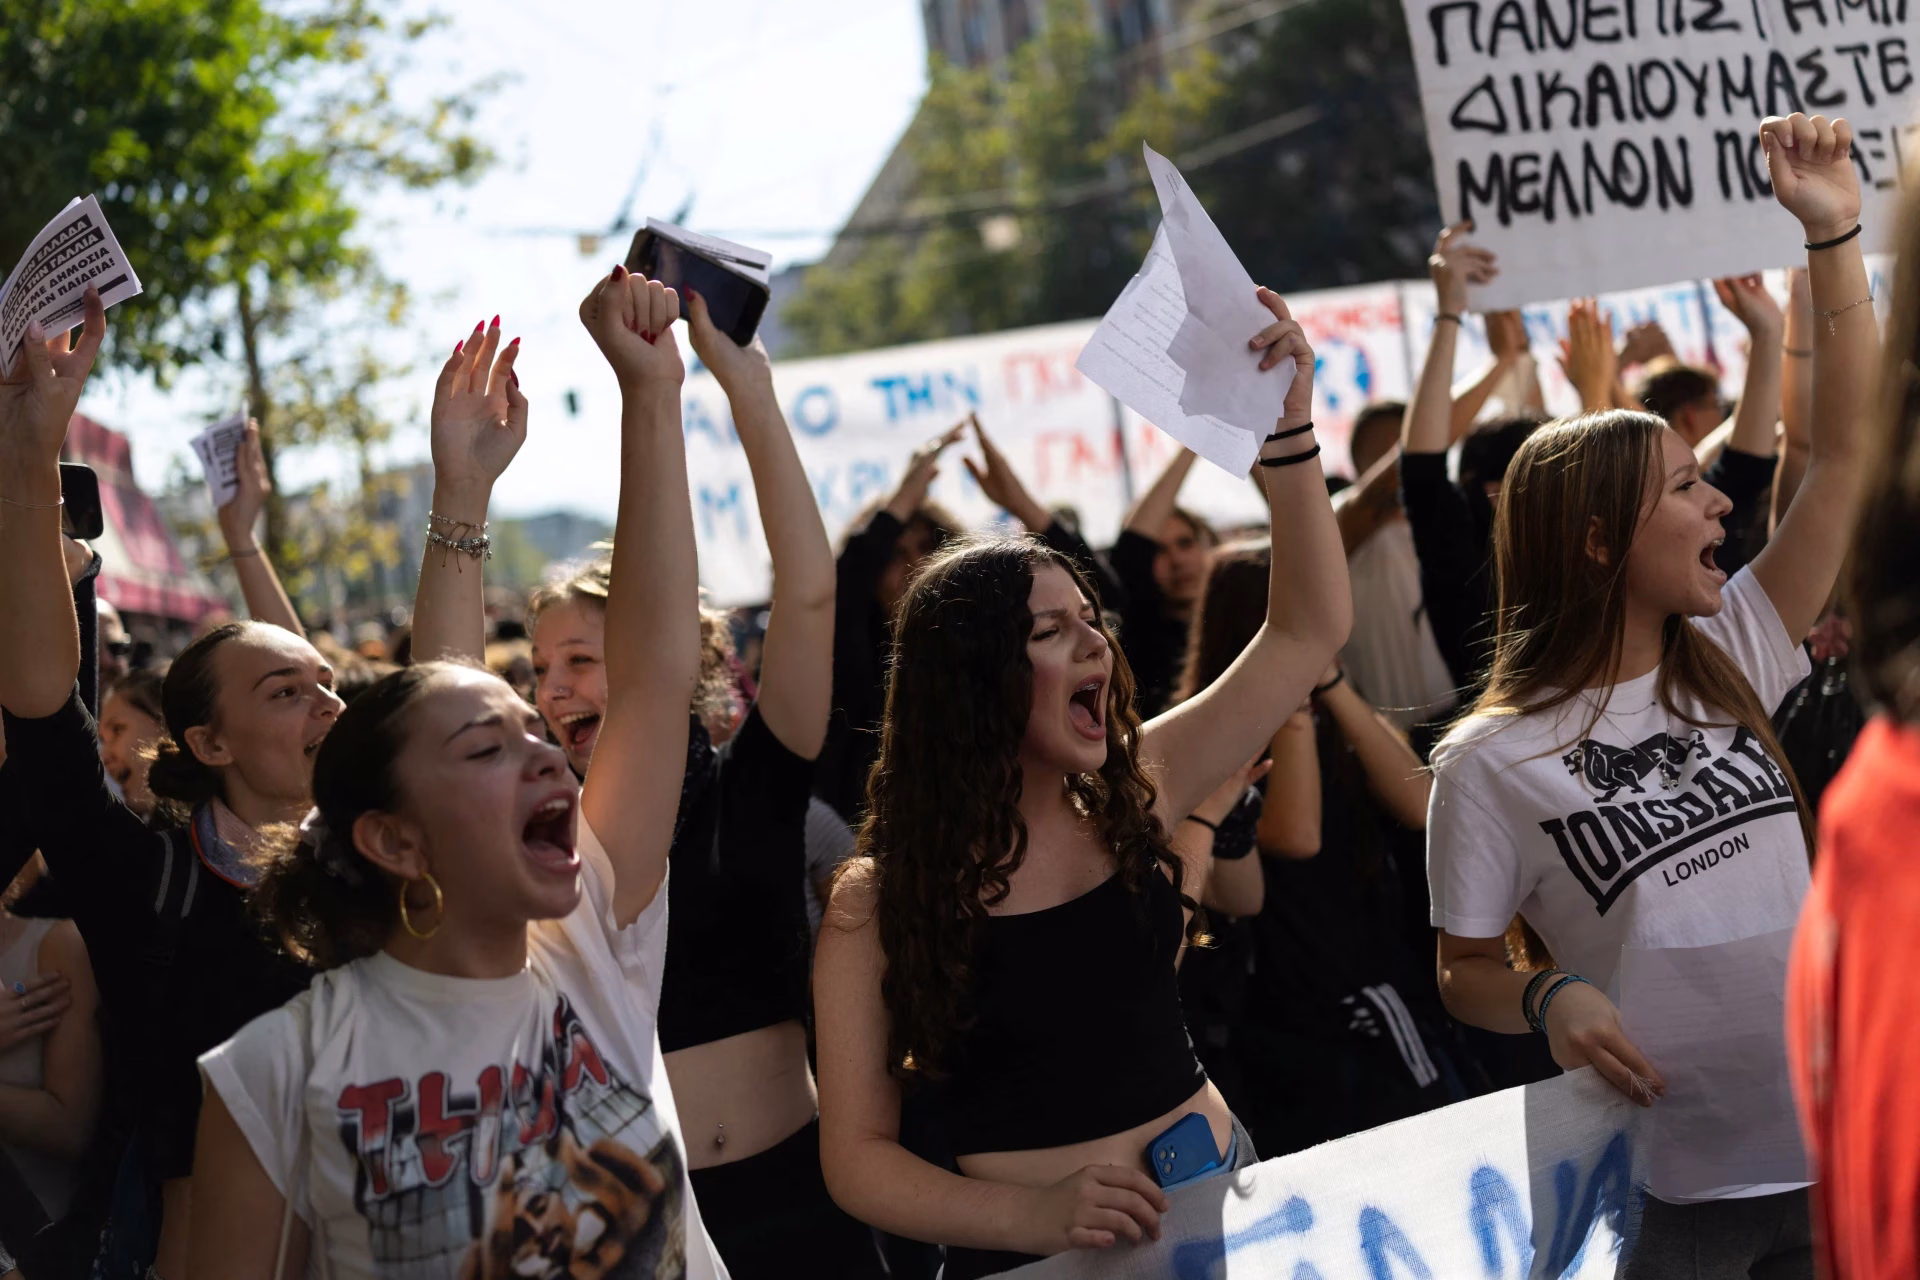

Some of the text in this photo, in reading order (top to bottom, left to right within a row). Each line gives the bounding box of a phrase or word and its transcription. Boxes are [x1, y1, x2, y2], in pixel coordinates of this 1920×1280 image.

[1450, 38, 1914, 134] ΔΙΚΑΙΟΥΜΑΣΤΕ
[18, 261, 37, 286] ΤΗΝ
[36, 220, 88, 262] ΕΛΛΑΔΑ
[26, 265, 50, 292] ΤΗΝ
[49, 233, 99, 269] ΓΑΛΛΙΑ
[6, 285, 47, 341] ΘΕΛΟΥΜΕ
[49, 247, 110, 288] ΔΗΜΟΣΙΑ
[15, 292, 56, 338] ΔΩΡΕΑΝ
[57, 257, 116, 297] ΠΑΙΔΕΙΑ!
[1538, 726, 1794, 917] LONSDALE
[1661, 832, 1751, 887] LONDON
